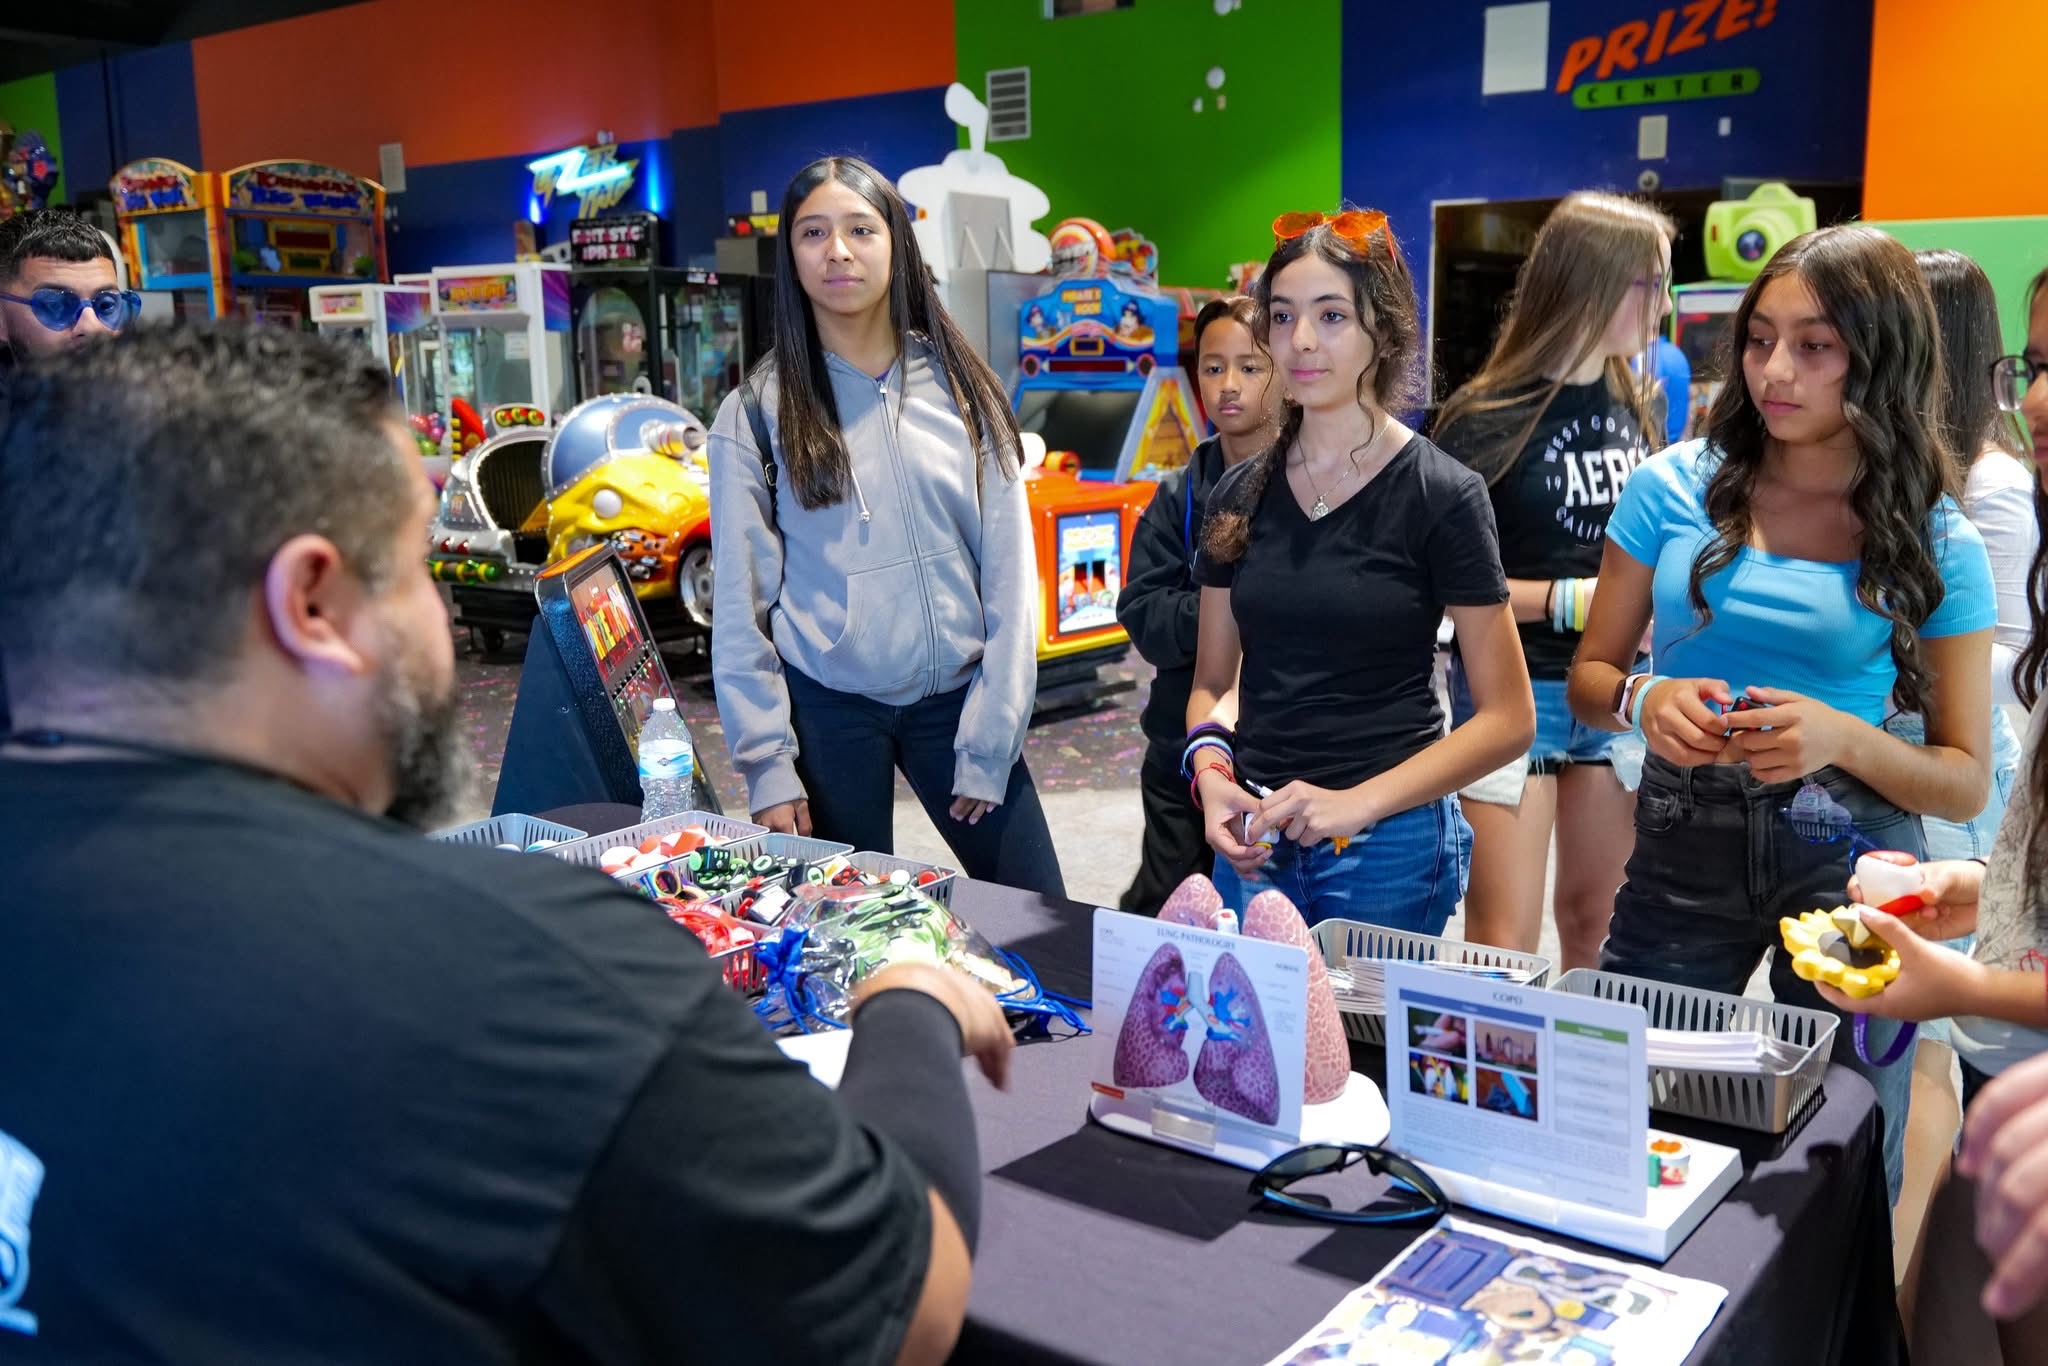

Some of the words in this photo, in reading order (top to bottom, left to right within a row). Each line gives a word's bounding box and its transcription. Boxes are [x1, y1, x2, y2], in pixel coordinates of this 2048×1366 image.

[1587, 73, 1745, 104] CENTER
[1544, 419, 1580, 463] WEST
[1546, 475, 1561, 492] 19
[1157, 927, 1179, 940] LUNG
